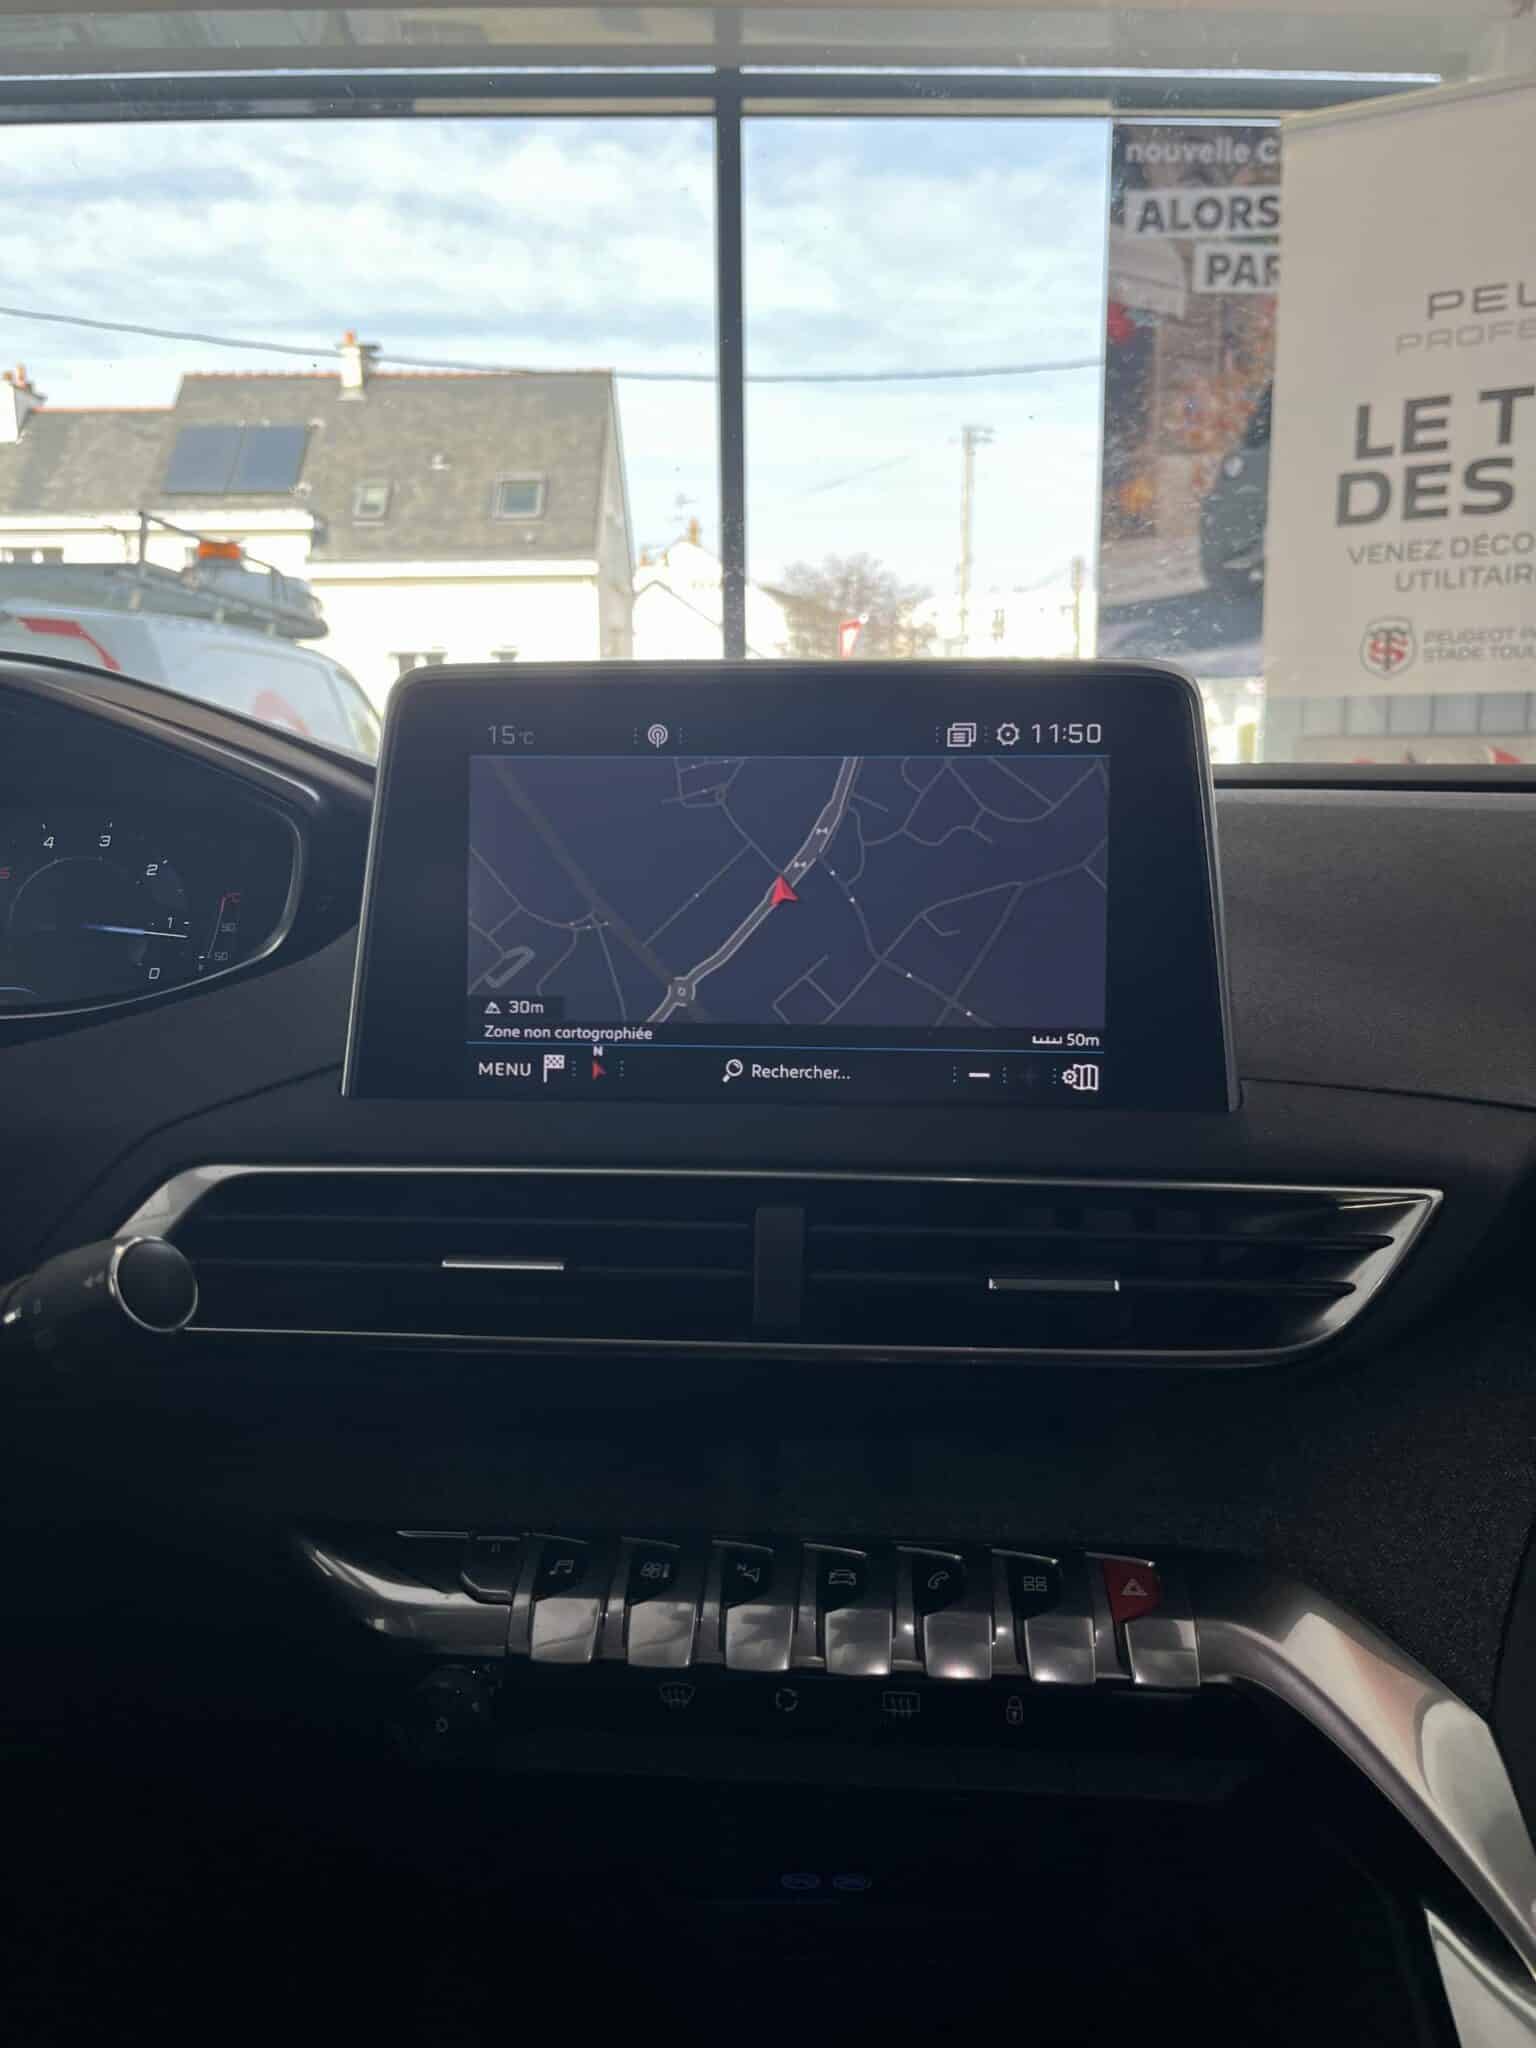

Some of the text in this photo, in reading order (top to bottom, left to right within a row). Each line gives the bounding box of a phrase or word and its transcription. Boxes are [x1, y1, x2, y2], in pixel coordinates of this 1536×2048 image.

[1126, 136, 1251, 164] nouvelle
[1137, 196, 1279, 232] ALORS
[1355, 394, 1452, 460] LE
[1336, 457, 1516, 527] DES
[1347, 539, 1443, 565] VENEZ
[1395, 562, 1536, 592] UTILITAIR
[1031, 723, 1102, 744] 11:50
[43, 836, 54, 847] 4
[100, 835, 111, 847] 3
[146, 864, 158, 876] 2
[167, 917, 173, 929] 1
[508, 1000, 544, 1014] 30m
[484, 1025, 653, 1041] Zone non cartographiée
[1067, 1034, 1100, 1047] 50m
[593, 1046, 603, 1056] N
[478, 1062, 531, 1077] MENU
[751, 1064, 851, 1082] Rechercher...
